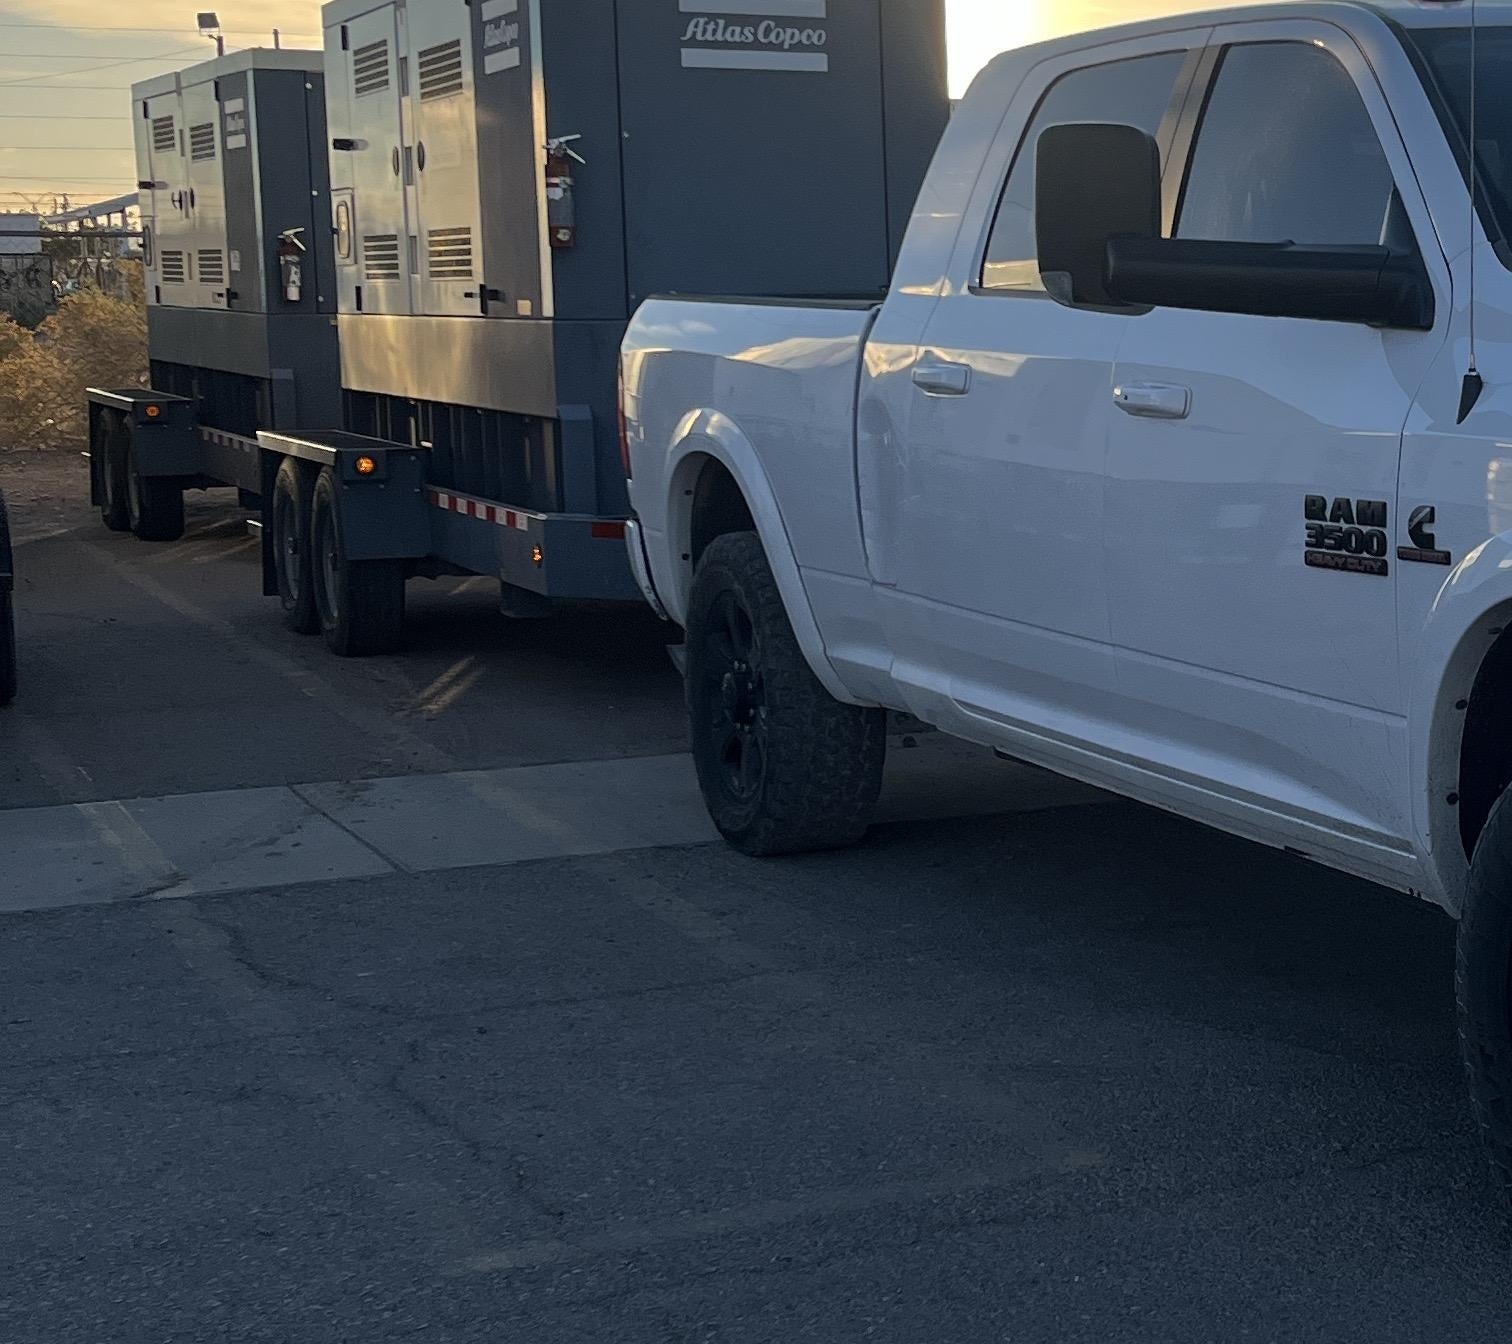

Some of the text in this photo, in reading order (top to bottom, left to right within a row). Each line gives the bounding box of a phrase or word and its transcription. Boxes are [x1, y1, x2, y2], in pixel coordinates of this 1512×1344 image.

[680, 17, 827, 49] Atlas Copco
[1304, 494, 1387, 528] RAM
[1305, 522, 1388, 557] 3500
